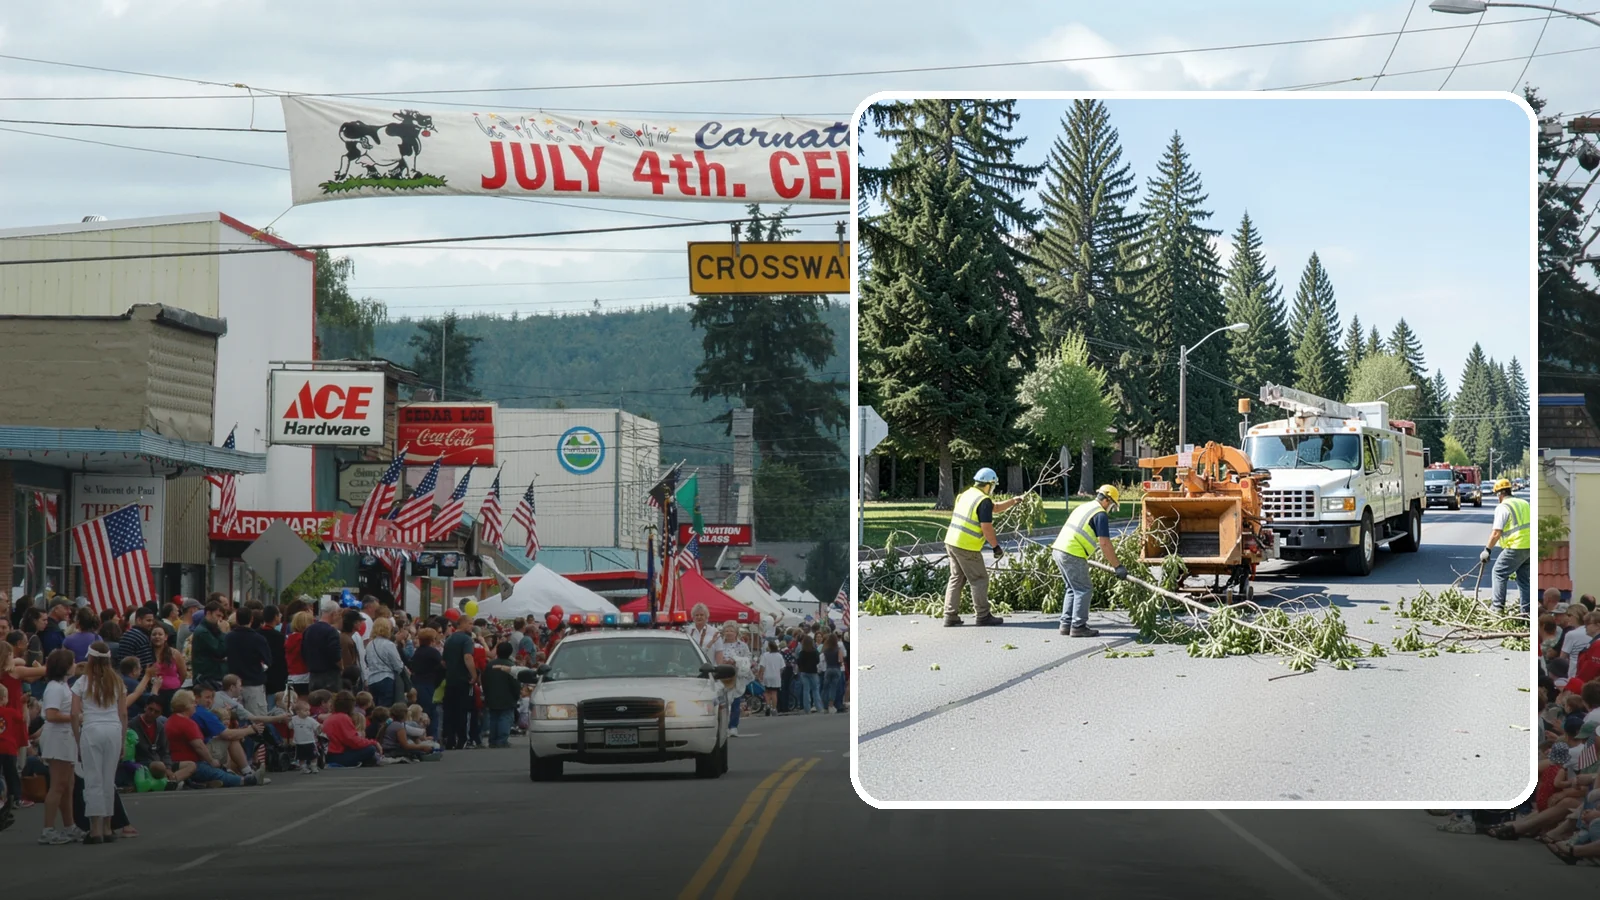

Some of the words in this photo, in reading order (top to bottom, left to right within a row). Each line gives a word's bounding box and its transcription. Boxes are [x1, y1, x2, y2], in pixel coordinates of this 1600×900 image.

[481, 140, 604, 192] JULY
[632, 150, 746, 198] 4th.
[697, 254, 850, 280] CROSSWA
[283, 380, 373, 420] ACE
[405, 409, 452, 422] CEDAR
[461, 409, 485, 422] LOG
[284, 421, 370, 436] Hardware
[416, 428, 476, 446] Coca-Cola
[353, 467, 386, 479] Simpl
[95, 484, 124, 495] Vincent
[126, 486, 135, 495] de
[137, 486, 155, 495] Paul
[212, 516, 330, 535] HARDARE
[688, 526, 741, 535] CRNATION
[699, 535, 730, 544] GLASS
